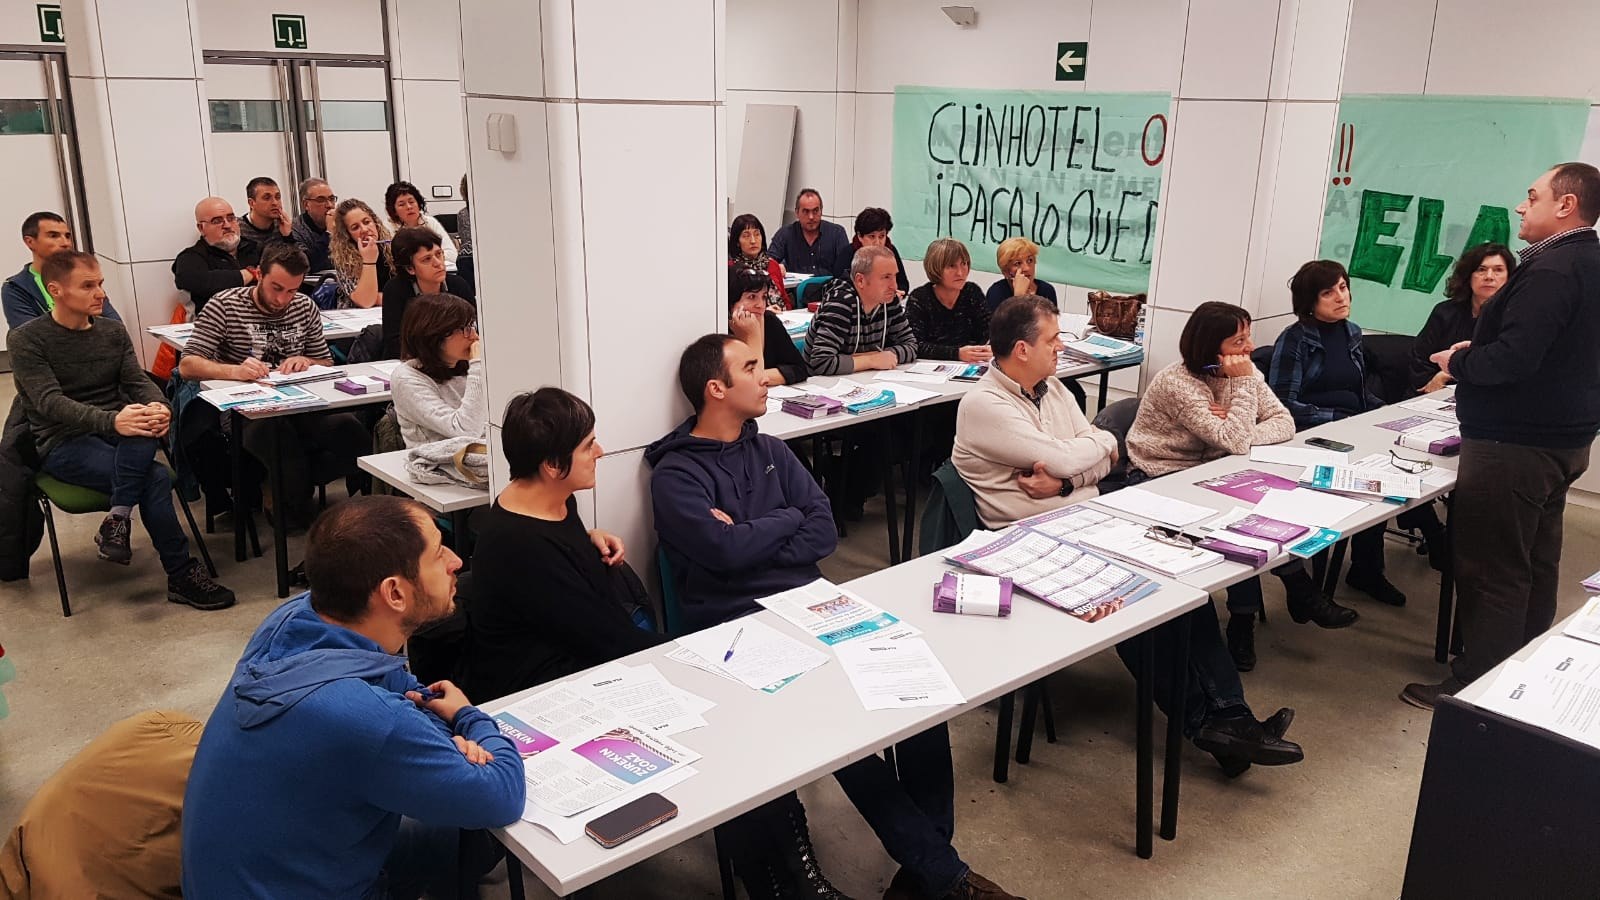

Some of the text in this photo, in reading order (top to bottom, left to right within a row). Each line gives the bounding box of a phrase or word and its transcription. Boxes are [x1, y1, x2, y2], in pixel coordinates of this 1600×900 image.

[1348, 189, 1511, 294] ELA
[598, 747, 649, 777] ZUREKIN
[624, 752, 658, 771] GOAZ
